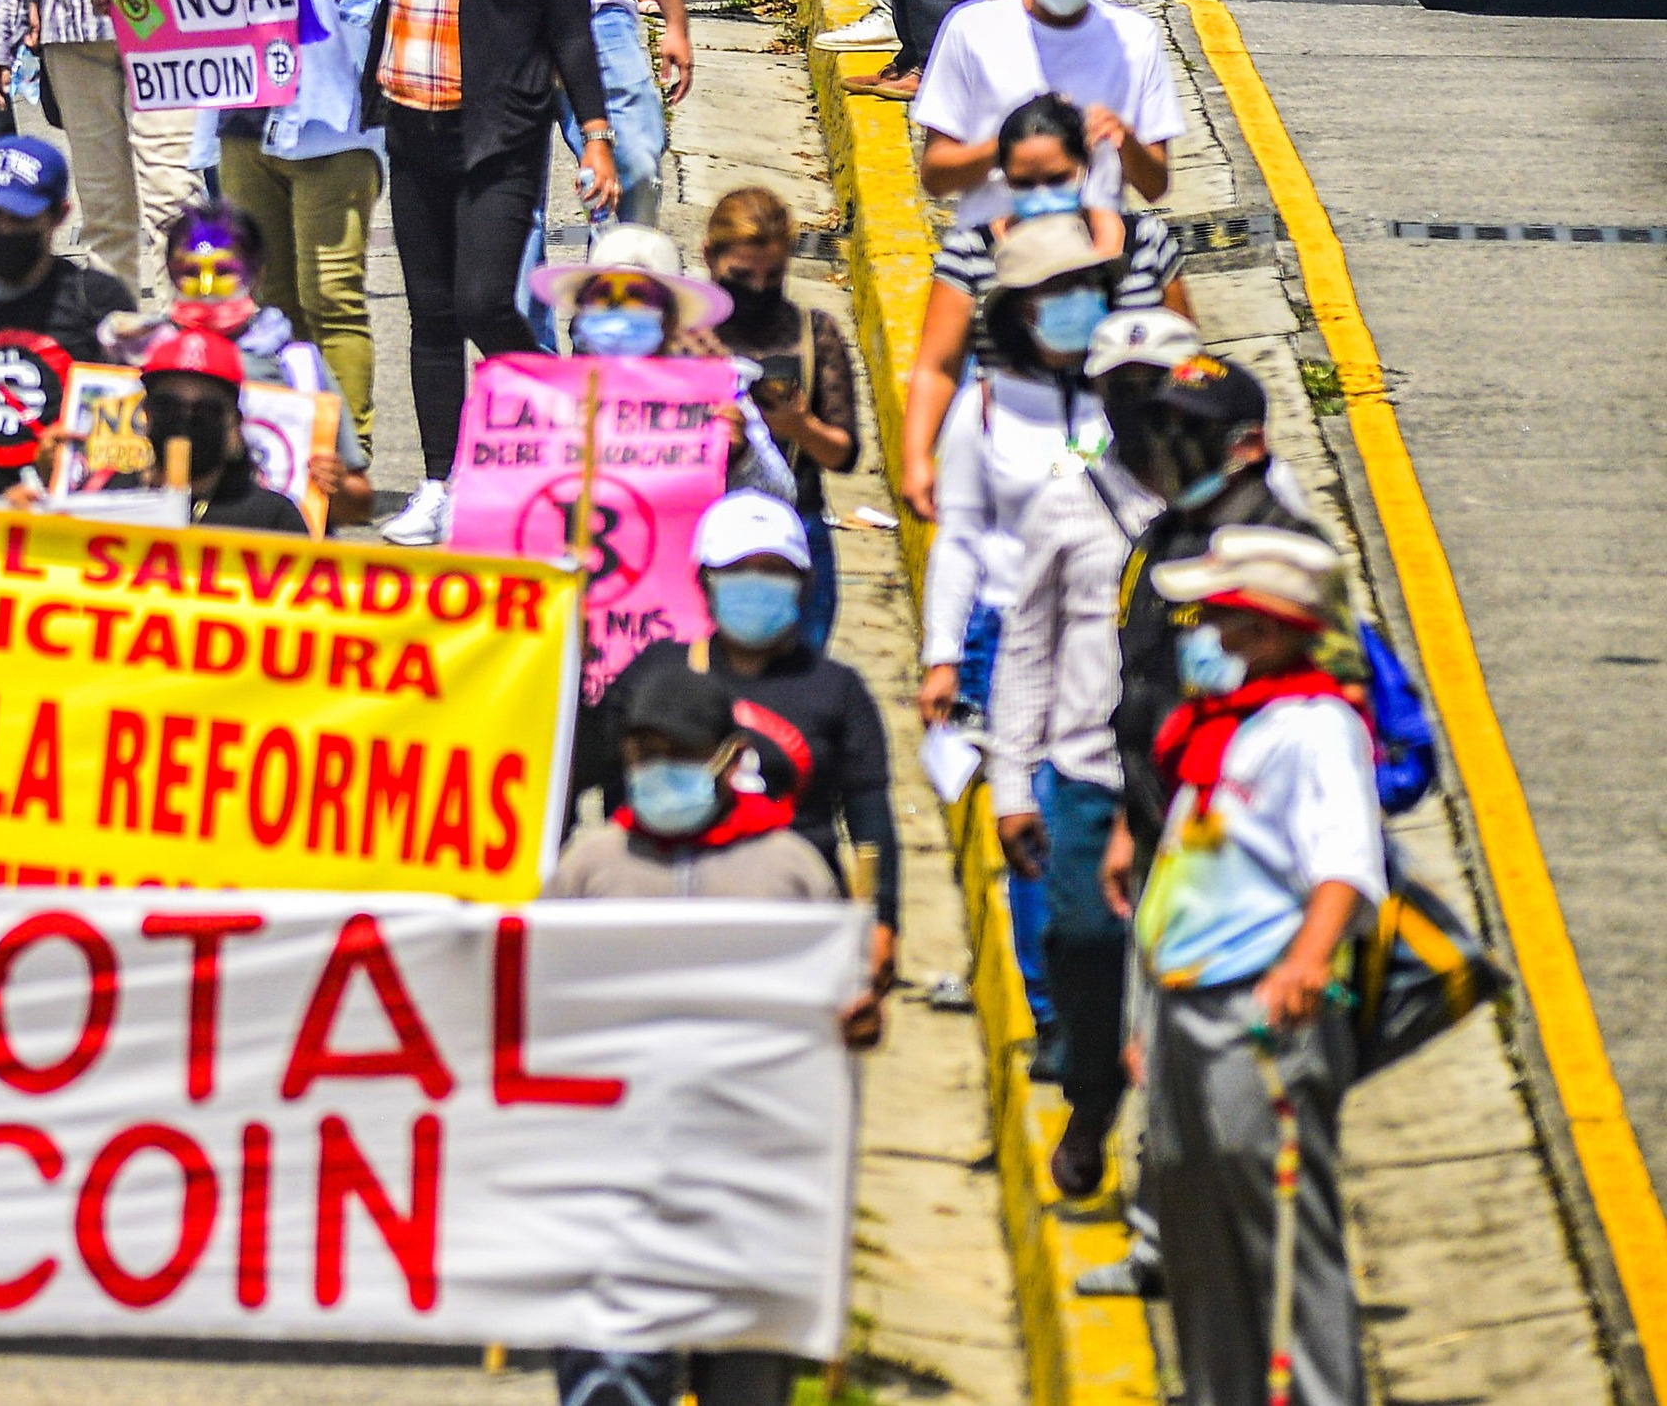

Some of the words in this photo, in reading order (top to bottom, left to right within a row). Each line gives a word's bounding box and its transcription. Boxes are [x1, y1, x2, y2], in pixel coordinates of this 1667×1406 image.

[132, 54, 255, 101] BITCOIN
[486, 390, 535, 430] LA
[472, 442, 542, 468] DEBE
[85, 534, 544, 631] SALVADOR
[98, 708, 524, 874] REFORMAS
